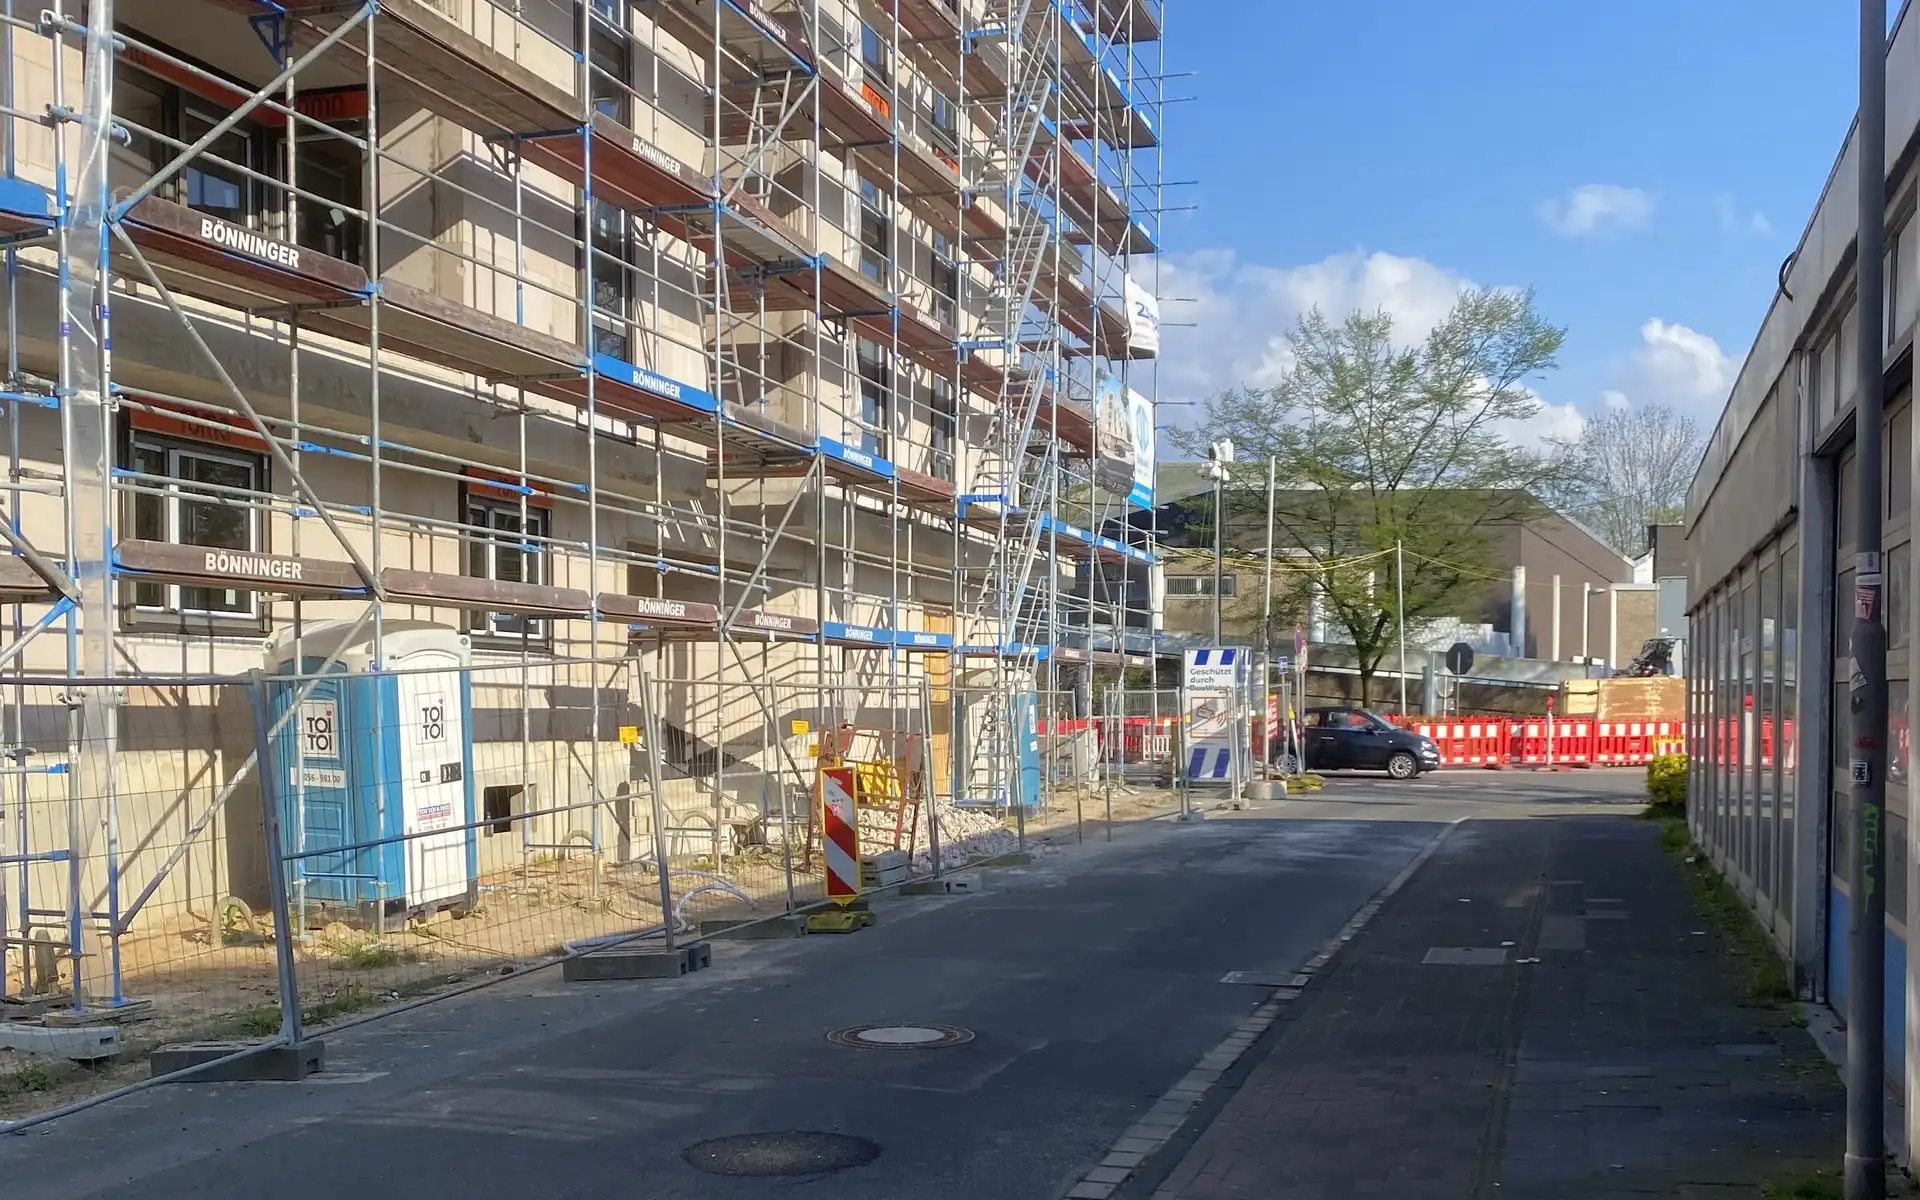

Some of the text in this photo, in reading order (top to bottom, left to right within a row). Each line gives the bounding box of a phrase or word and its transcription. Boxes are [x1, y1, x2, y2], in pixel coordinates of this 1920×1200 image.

[749, 1, 787, 42] BÖNNINGER
[633, 137, 681, 176] BÖNNINGER
[201, 218, 300, 268] BÖNNINGER
[633, 368, 681, 399] BÖNNINGER
[205, 550, 302, 580] BÖNNINGER
[638, 598, 686, 617] BÖNNINGER
[755, 612, 792, 630] BÖNNINGER
[1190, 667, 1232, 675] Geschützt
[422, 705, 443, 723] TOI
[307, 716, 331, 733] TOI
[422, 723, 444, 740] TOI
[307, 734, 332, 751] TOI
